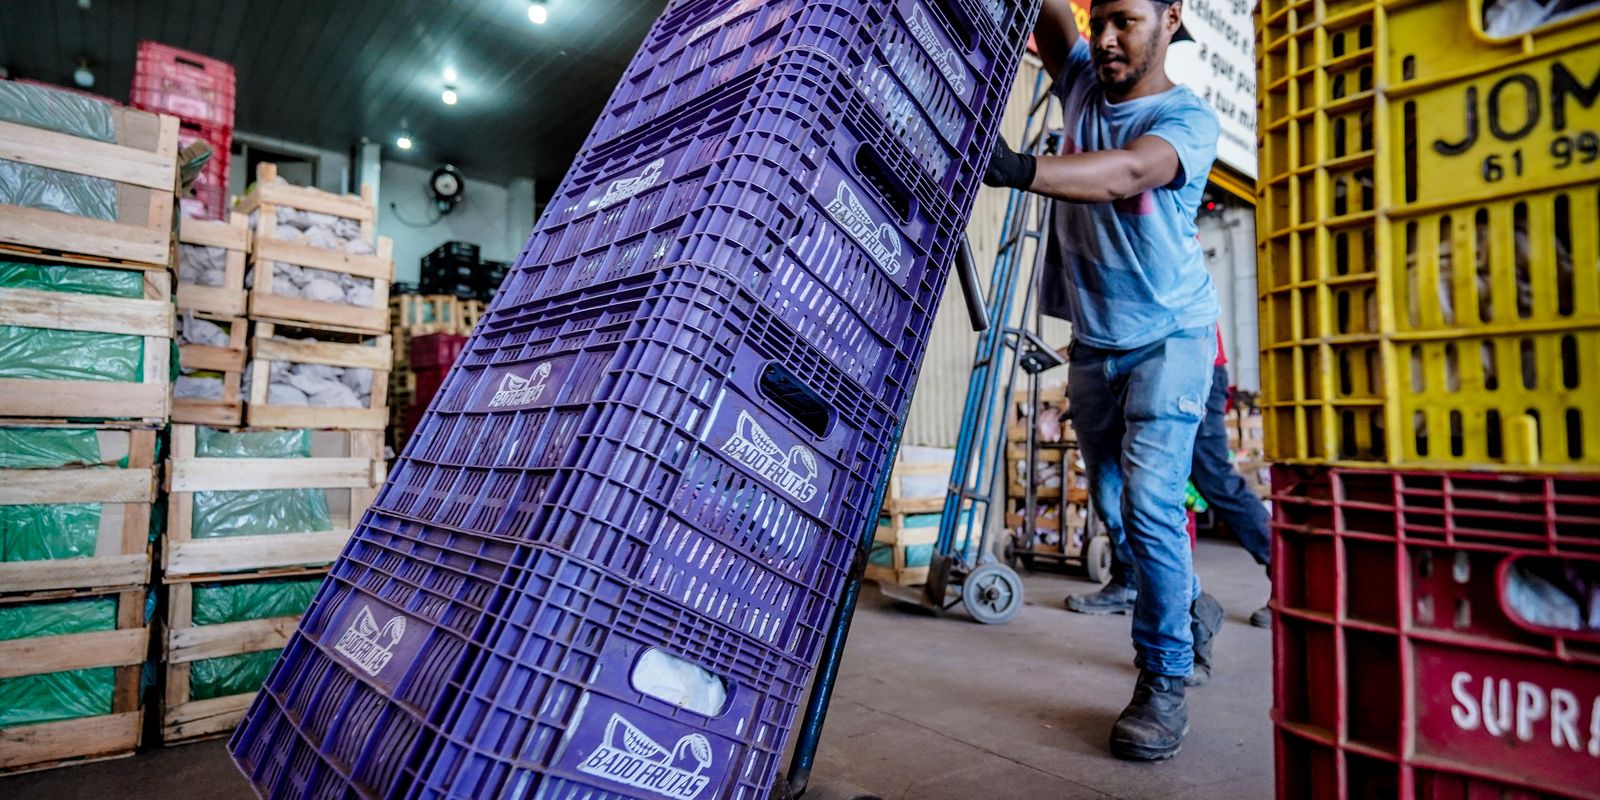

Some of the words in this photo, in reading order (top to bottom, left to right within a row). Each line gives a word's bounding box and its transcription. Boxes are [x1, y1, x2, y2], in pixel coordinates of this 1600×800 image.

[906, 19, 935, 52] BADO
[930, 50, 965, 94] FRUTAS
[1199, 42, 1208, 61] a
[1211, 52, 1235, 82] que
[1215, 90, 1236, 119] tua
[1481, 147, 1523, 184] 61
[827, 200, 864, 235] BADO
[859, 231, 899, 275] FRUTAS
[723, 437, 769, 472] BADO
[763, 462, 815, 502] FRUTAS
[586, 747, 644, 779] BADO
[634, 763, 704, 798] FRUTAS
